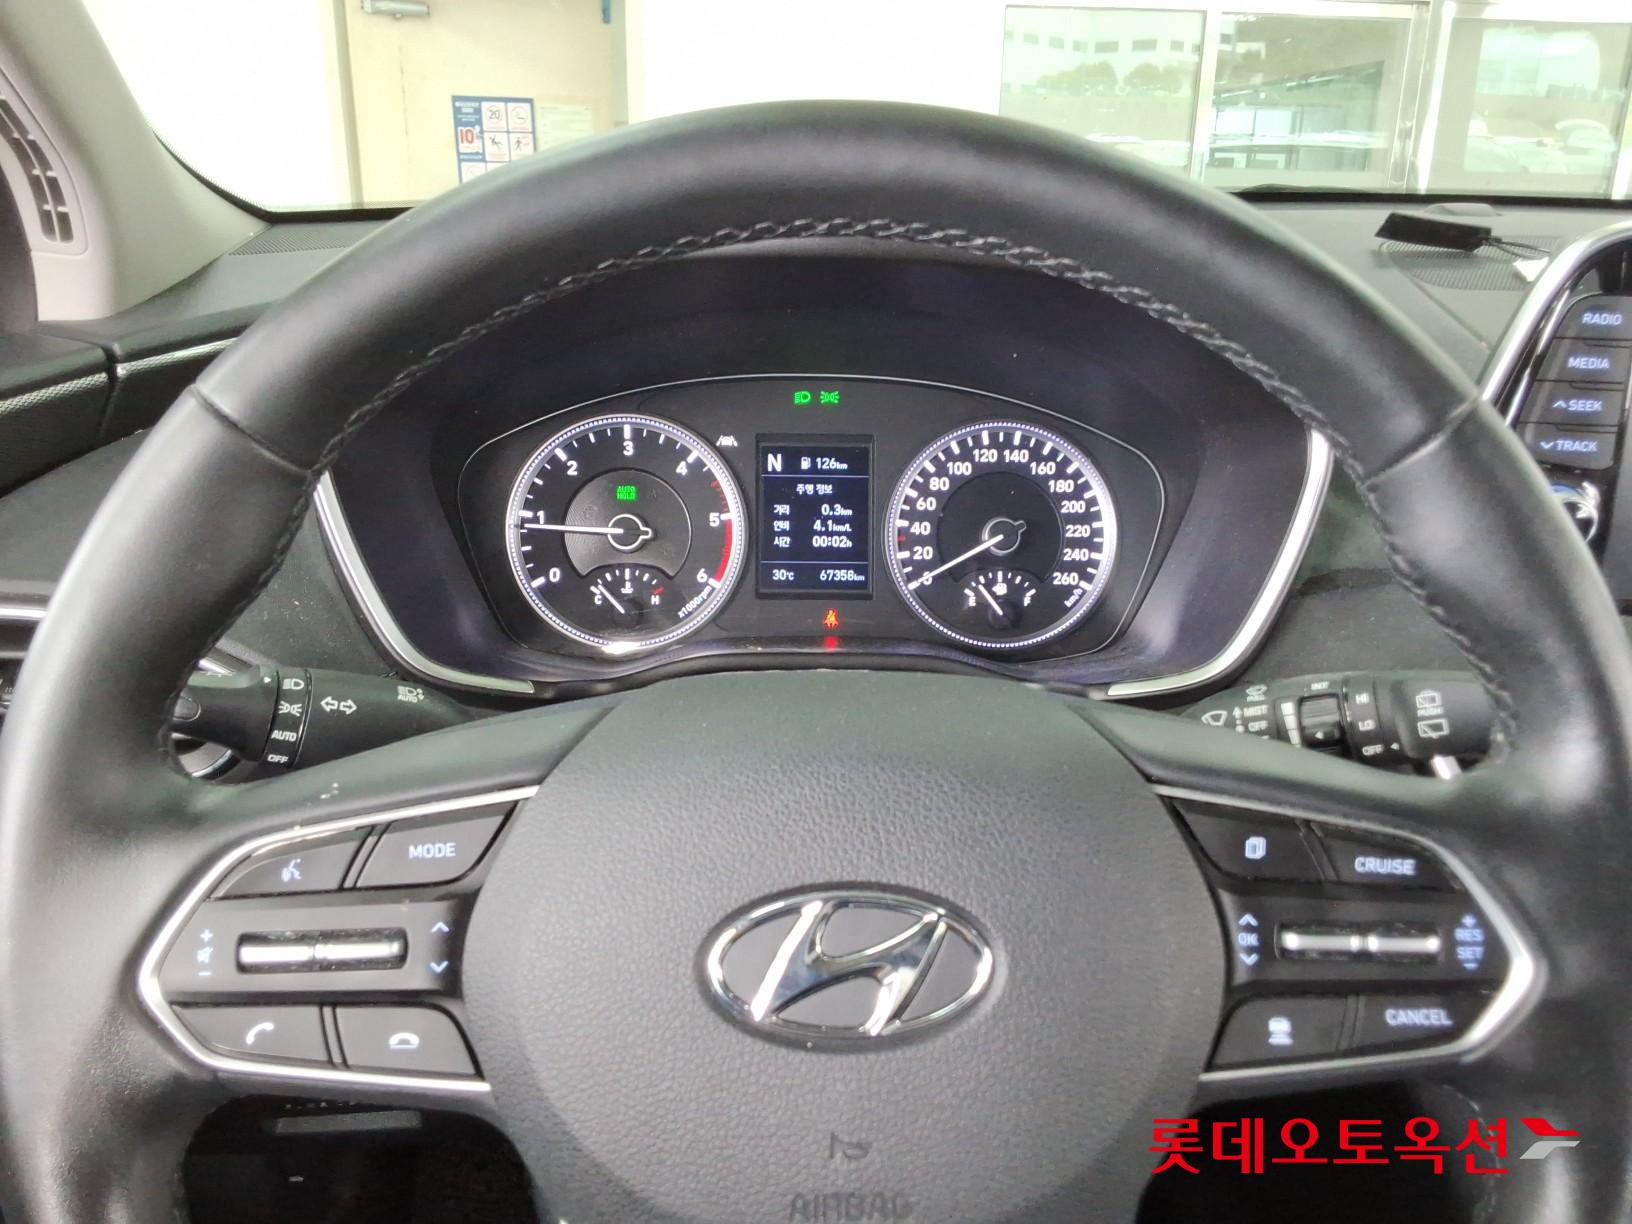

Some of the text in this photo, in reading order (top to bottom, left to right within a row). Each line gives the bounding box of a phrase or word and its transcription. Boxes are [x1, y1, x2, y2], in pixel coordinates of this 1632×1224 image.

[1582, 313, 1623, 327] RADIO
[1568, 357, 1609, 369] MEDIA
[1568, 400, 1602, 412] SEEK
[623, 441, 634, 456] 3
[1557, 440, 1598, 452] TRACK
[767, 453, 783, 472] N
[973, 449, 998, 463] 120
[1003, 449, 1029, 463] 140
[566, 461, 578, 476] 2
[675, 461, 688, 476] 4
[816, 457, 848, 470] 126km
[947, 461, 972, 476] 100
[1030, 461, 1056, 476] 160
[796, 484, 833, 495] 주행 정보
[929, 477, 950, 491] 80
[1048, 480, 1075, 494] 180
[617, 492, 636, 500] HOLD
[773, 504, 790, 516] 거리
[821, 504, 853, 516] 0.3km
[916, 497, 937, 511] 60
[1060, 500, 1086, 514] 200
[536, 510, 544, 525] 1
[709, 513, 720, 527] 5
[773, 520, 790, 532] 연비
[910, 521, 931, 535] 40
[1065, 525, 1091, 538] 220
[773, 536, 791, 548] 시간
[812, 536, 853, 548] 00:02h
[912, 546, 933, 560] 20
[1063, 548, 1089, 562] 240
[549, 567, 560, 583] 0
[696, 568, 707, 583] 6
[820, 569, 865, 581] 67358km
[1053, 572, 1079, 586] 260
[594, 594, 603, 605] C
[651, 594, 660, 605] H
[969, 596, 976, 606] E
[1023, 596, 1031, 606] F
[1064, 588, 1084, 608] km/h
[1356, 693, 1369, 703] HI
[1243, 705, 1269, 717] MIST
[1248, 721, 1268, 732] OFF
[1359, 720, 1376, 731] LO
[271, 730, 297, 742] AUTO
[1362, 745, 1384, 756] OFF
[267, 754, 288, 764] OFF
[409, 843, 456, 858] MODE
[1354, 857, 1416, 875] CRUISE
[1238, 933, 1258, 945] OK
[1455, 929, 1483, 941] RES
[1457, 948, 1483, 959] SET
[1385, 1009, 1452, 1026] CANCEL
